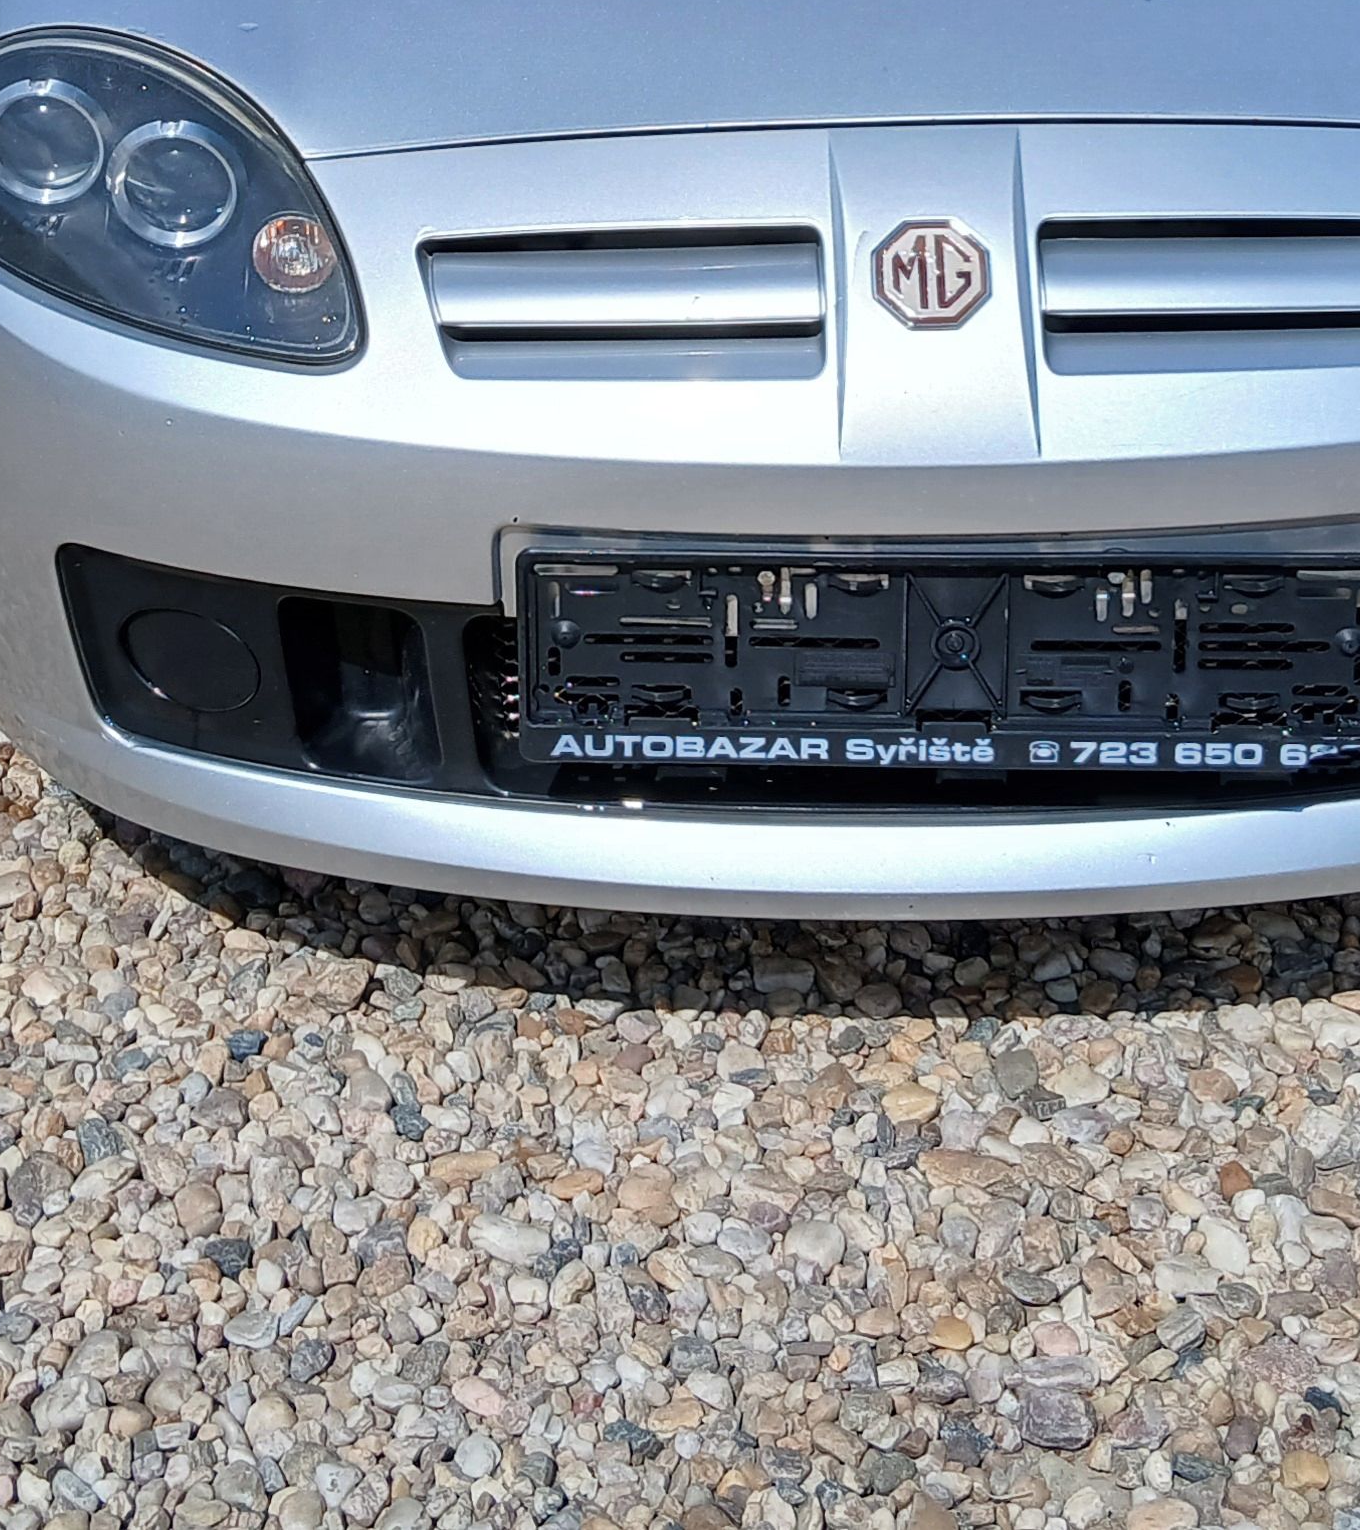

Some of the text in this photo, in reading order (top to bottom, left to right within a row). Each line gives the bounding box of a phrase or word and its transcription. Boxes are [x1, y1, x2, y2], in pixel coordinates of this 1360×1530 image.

[891, 233, 972, 310] MG
[550, 734, 829, 760] AUTOBAZAR
[845, 735, 995, 765] Syřiště
[1069, 740, 1158, 765] 723
[1174, 742, 1263, 766] 650
